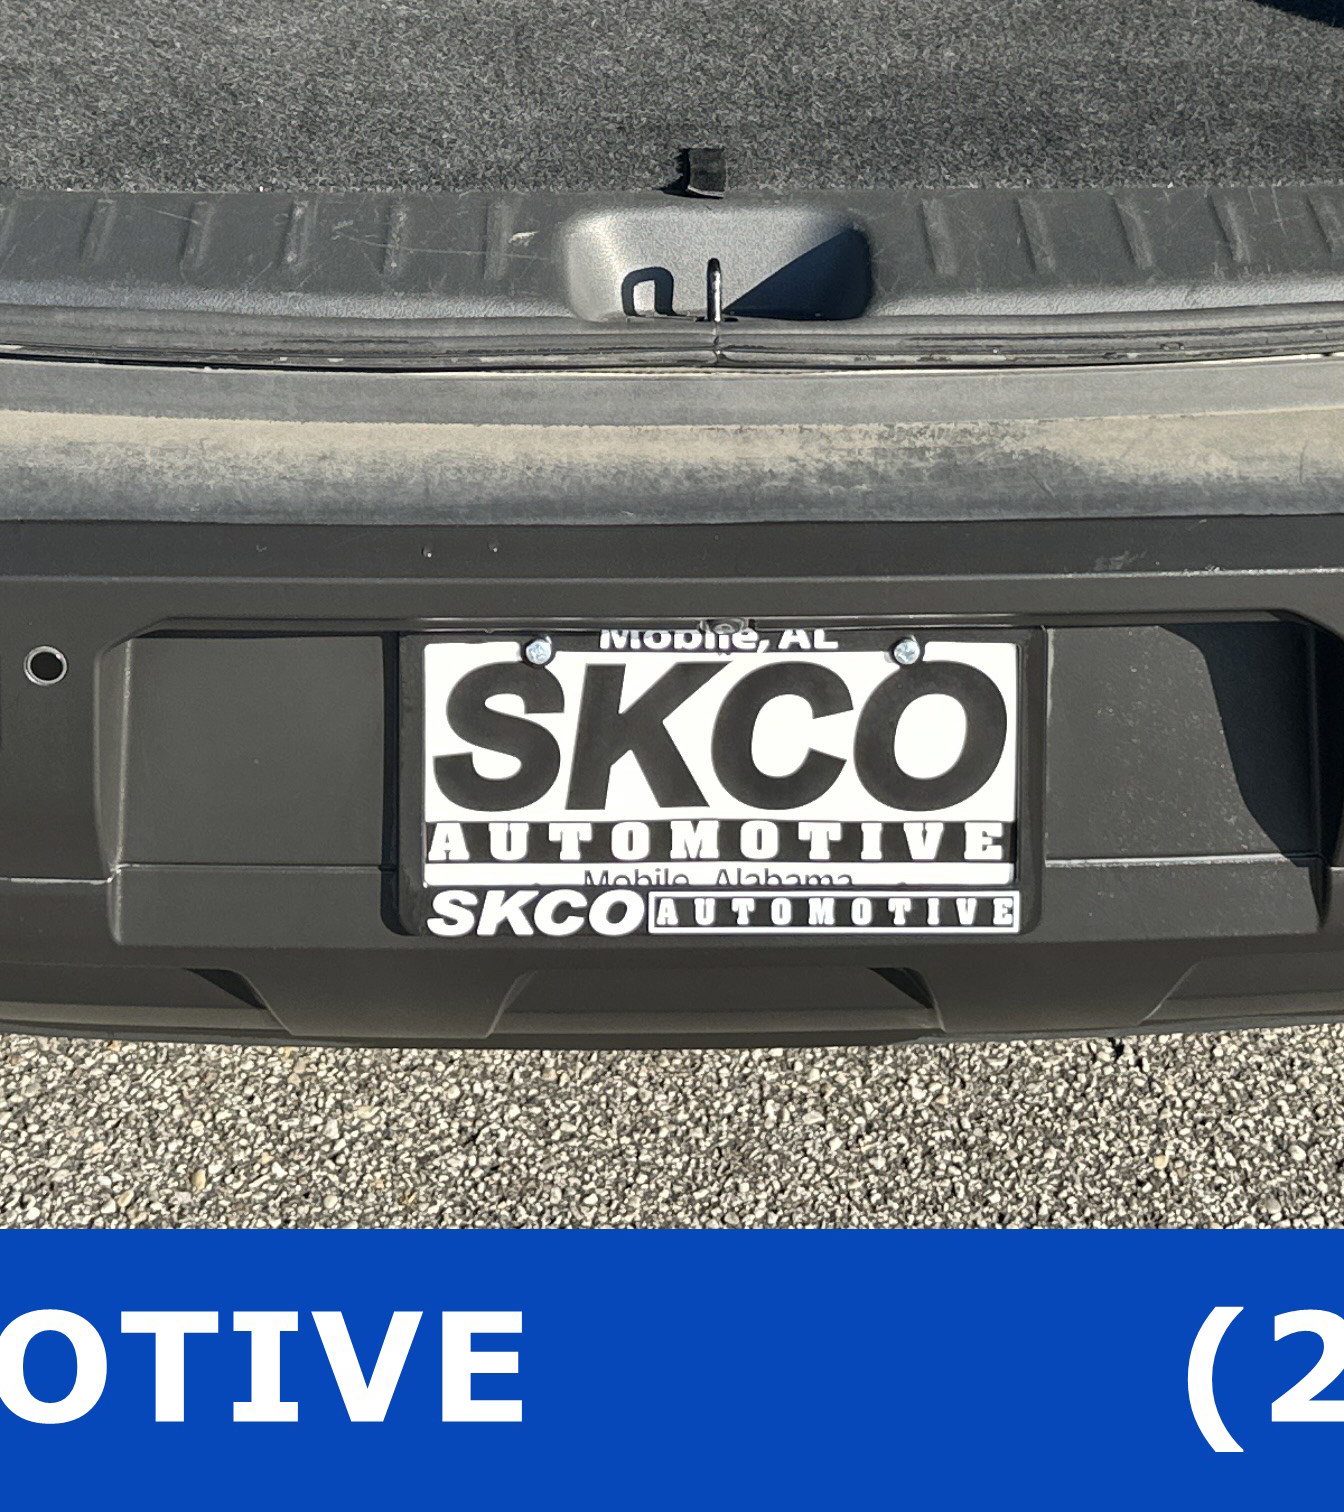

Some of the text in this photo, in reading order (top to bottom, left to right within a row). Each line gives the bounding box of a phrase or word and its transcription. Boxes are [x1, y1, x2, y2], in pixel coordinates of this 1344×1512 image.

[778, 628, 839, 650] AL
[432, 660, 1009, 813] SKCO
[428, 820, 1004, 861] AUTOMOTIVE
[426, 888, 1014, 937] SKCO AUTOMOTIVE
